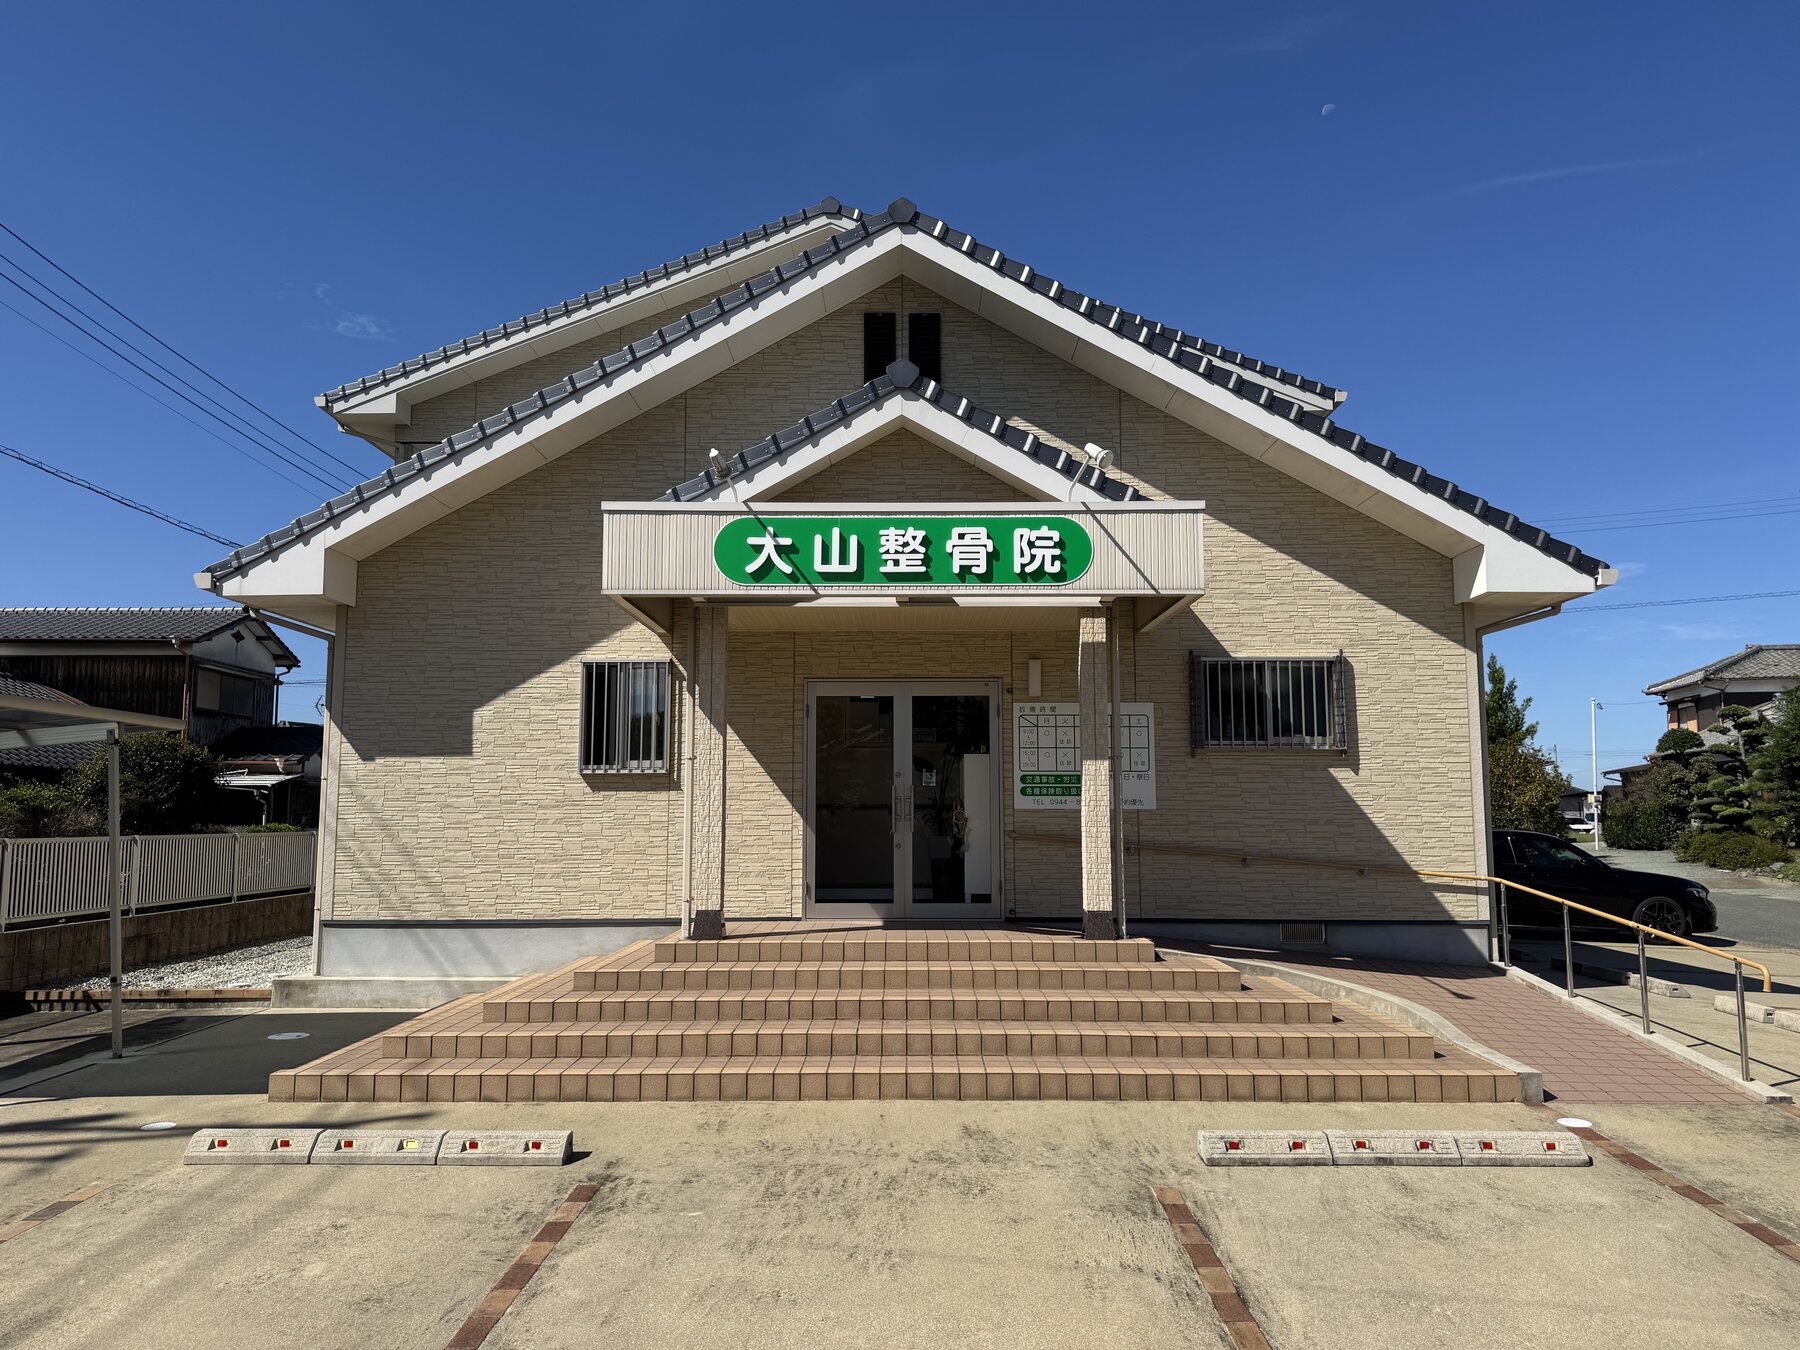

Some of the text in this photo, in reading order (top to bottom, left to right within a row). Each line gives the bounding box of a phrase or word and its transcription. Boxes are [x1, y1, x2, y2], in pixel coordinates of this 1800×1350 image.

[745, 525, 1061, 574] 大山整骨院
